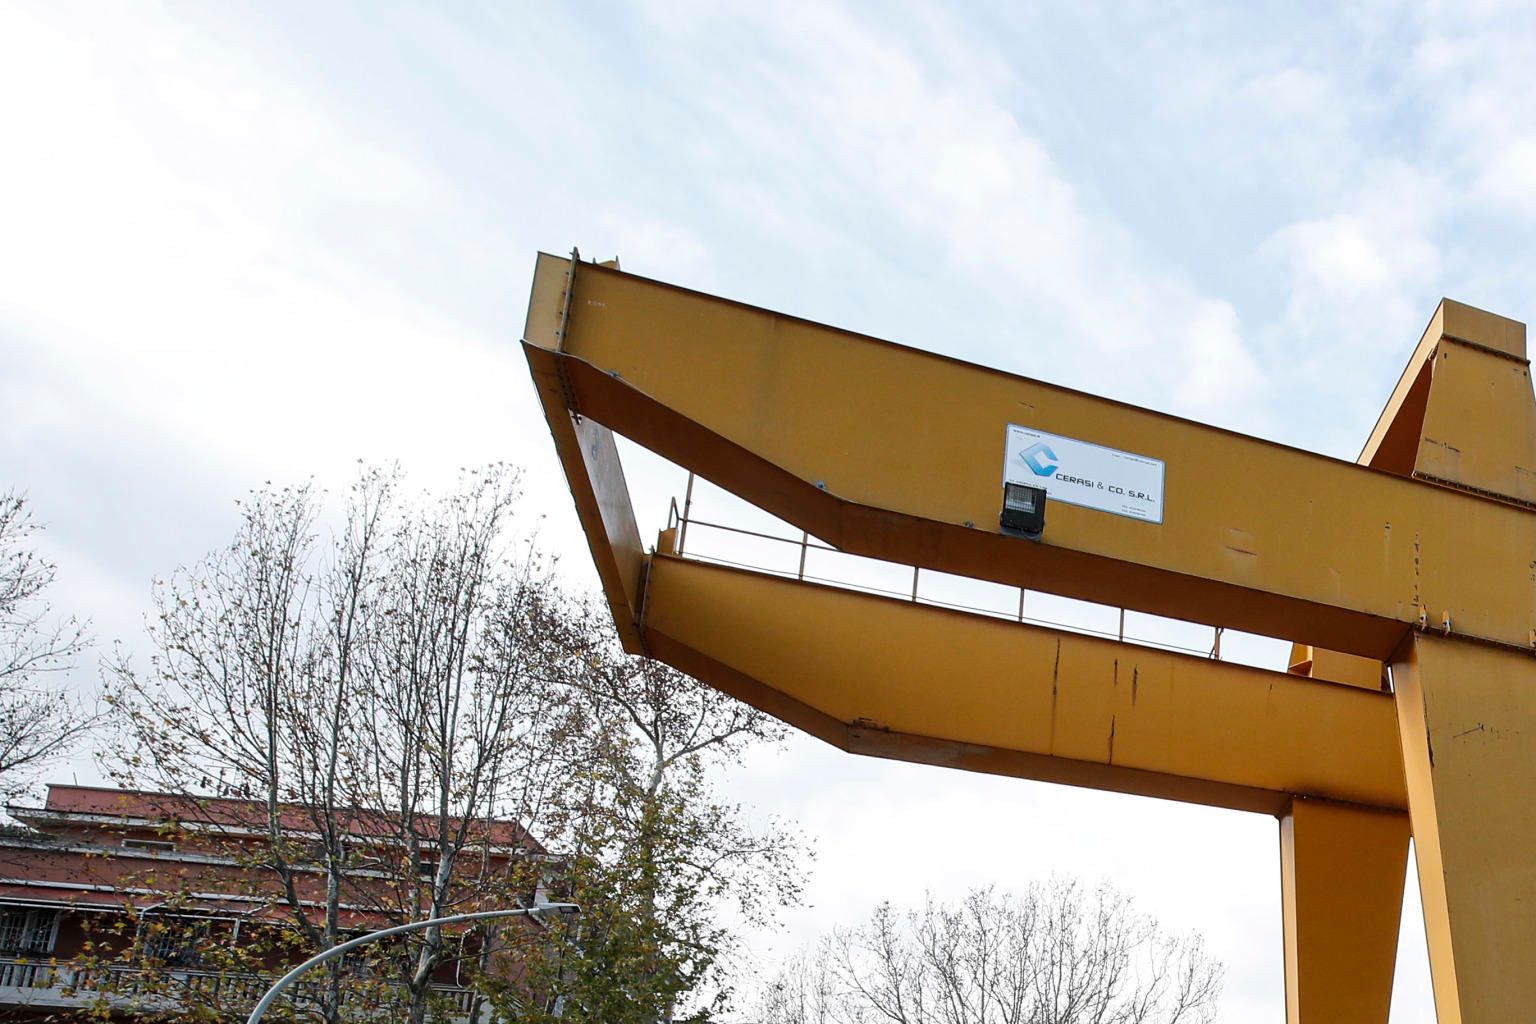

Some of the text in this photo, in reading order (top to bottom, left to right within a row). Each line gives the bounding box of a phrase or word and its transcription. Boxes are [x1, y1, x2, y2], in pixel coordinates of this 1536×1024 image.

[1055, 473, 1094, 488] CERASI
[1096, 481, 1104, 490] &
[1108, 485, 1125, 496] CO.
[1128, 490, 1156, 503] S.R.L.
